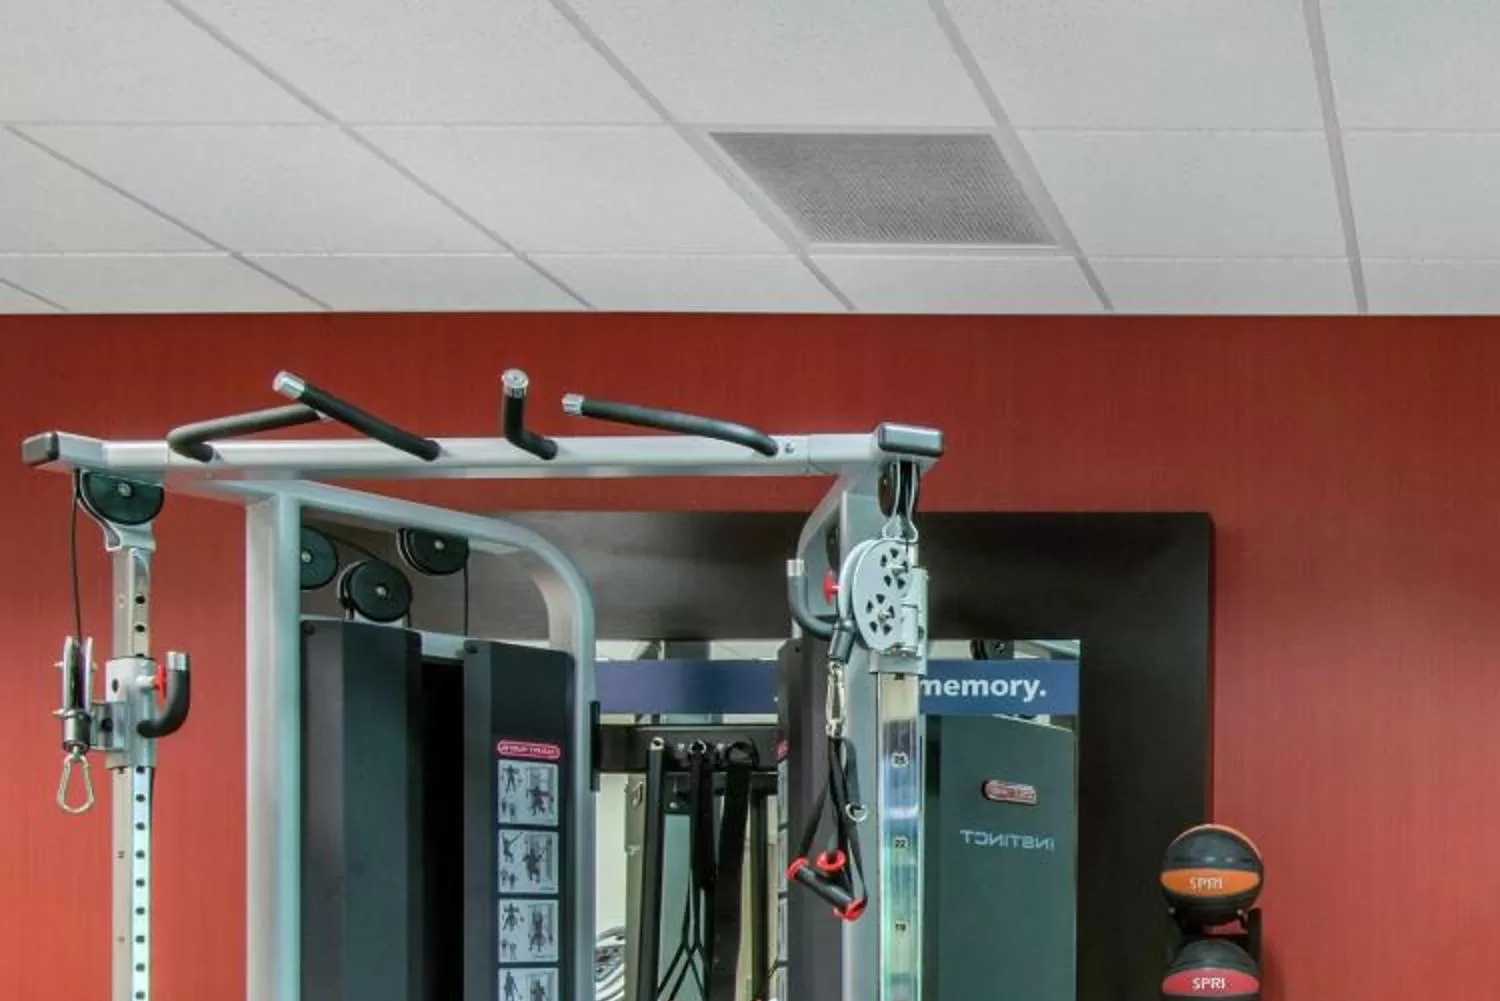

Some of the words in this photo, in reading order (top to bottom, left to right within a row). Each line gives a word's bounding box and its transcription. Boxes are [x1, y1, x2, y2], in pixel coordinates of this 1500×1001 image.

[920, 678, 1047, 702] memory.
[1189, 876, 1223, 890] SPRI
[1192, 976, 1226, 990] SPRI
